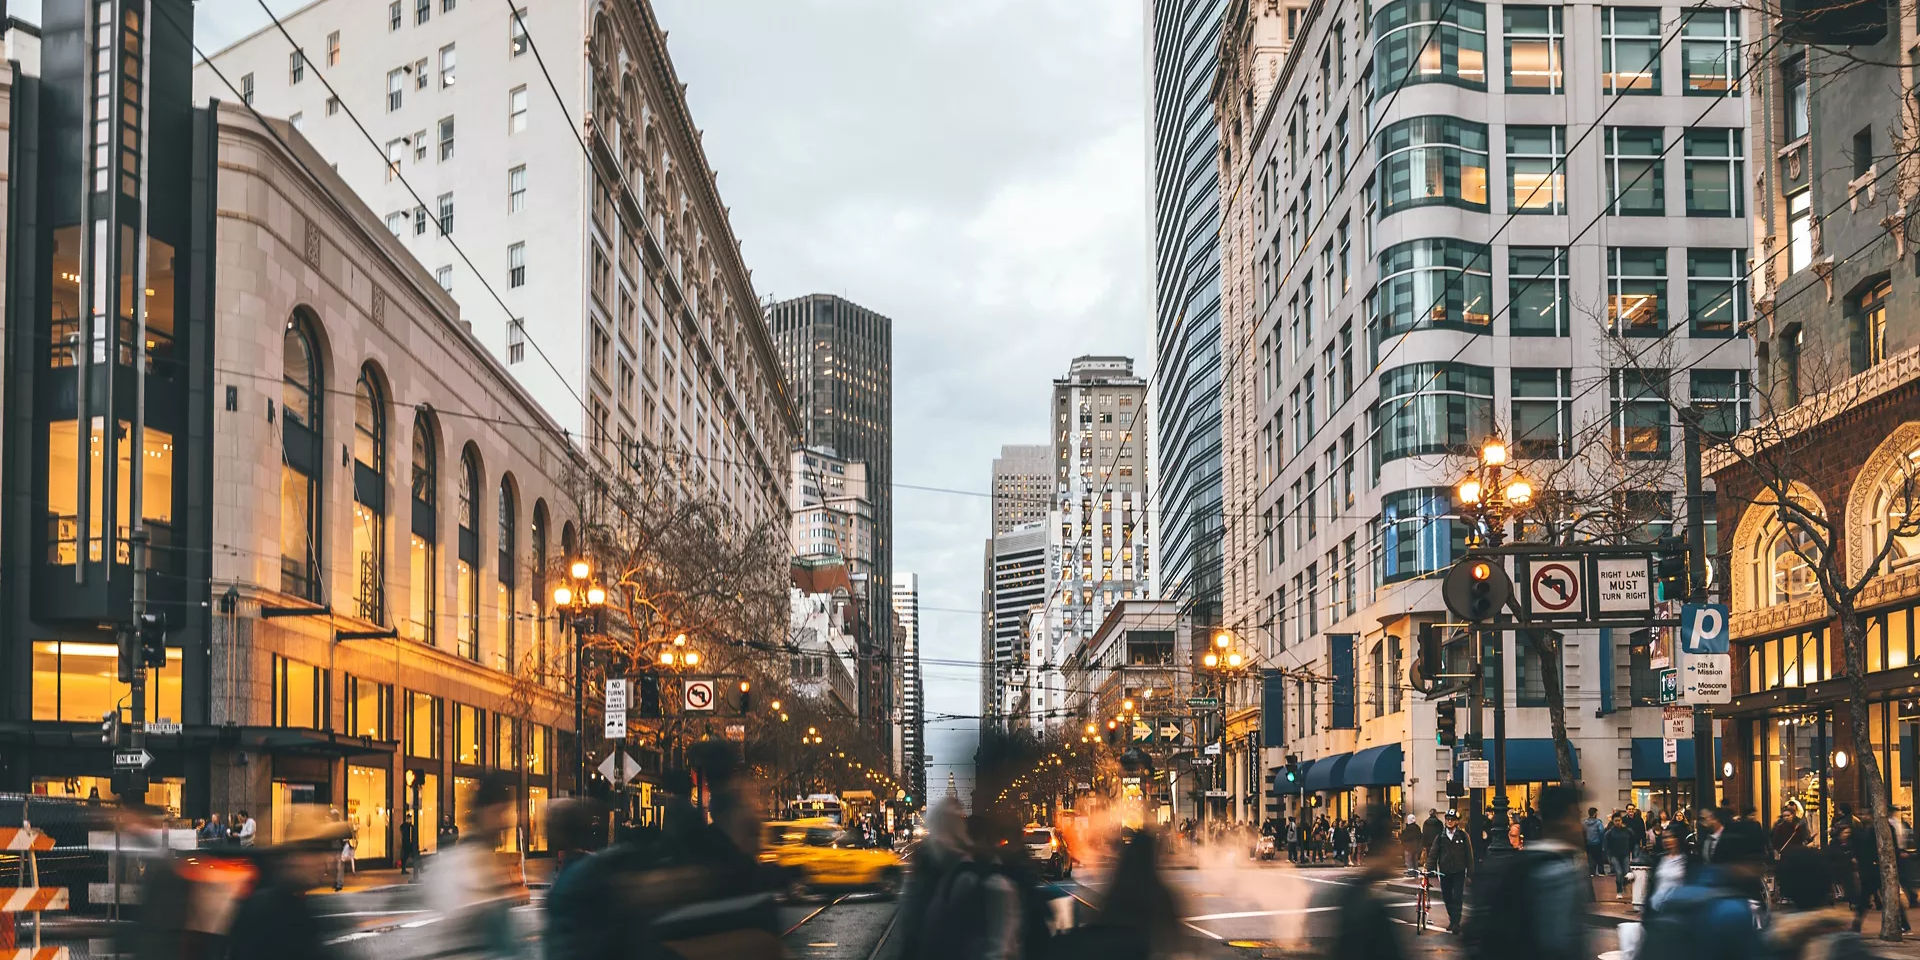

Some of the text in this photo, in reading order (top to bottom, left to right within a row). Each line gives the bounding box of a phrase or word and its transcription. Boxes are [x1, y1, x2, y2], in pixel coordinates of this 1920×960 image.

[1626, 570, 1646, 578] LANE
[1609, 580, 1637, 590] MUST
[611, 681, 621, 689] NO
